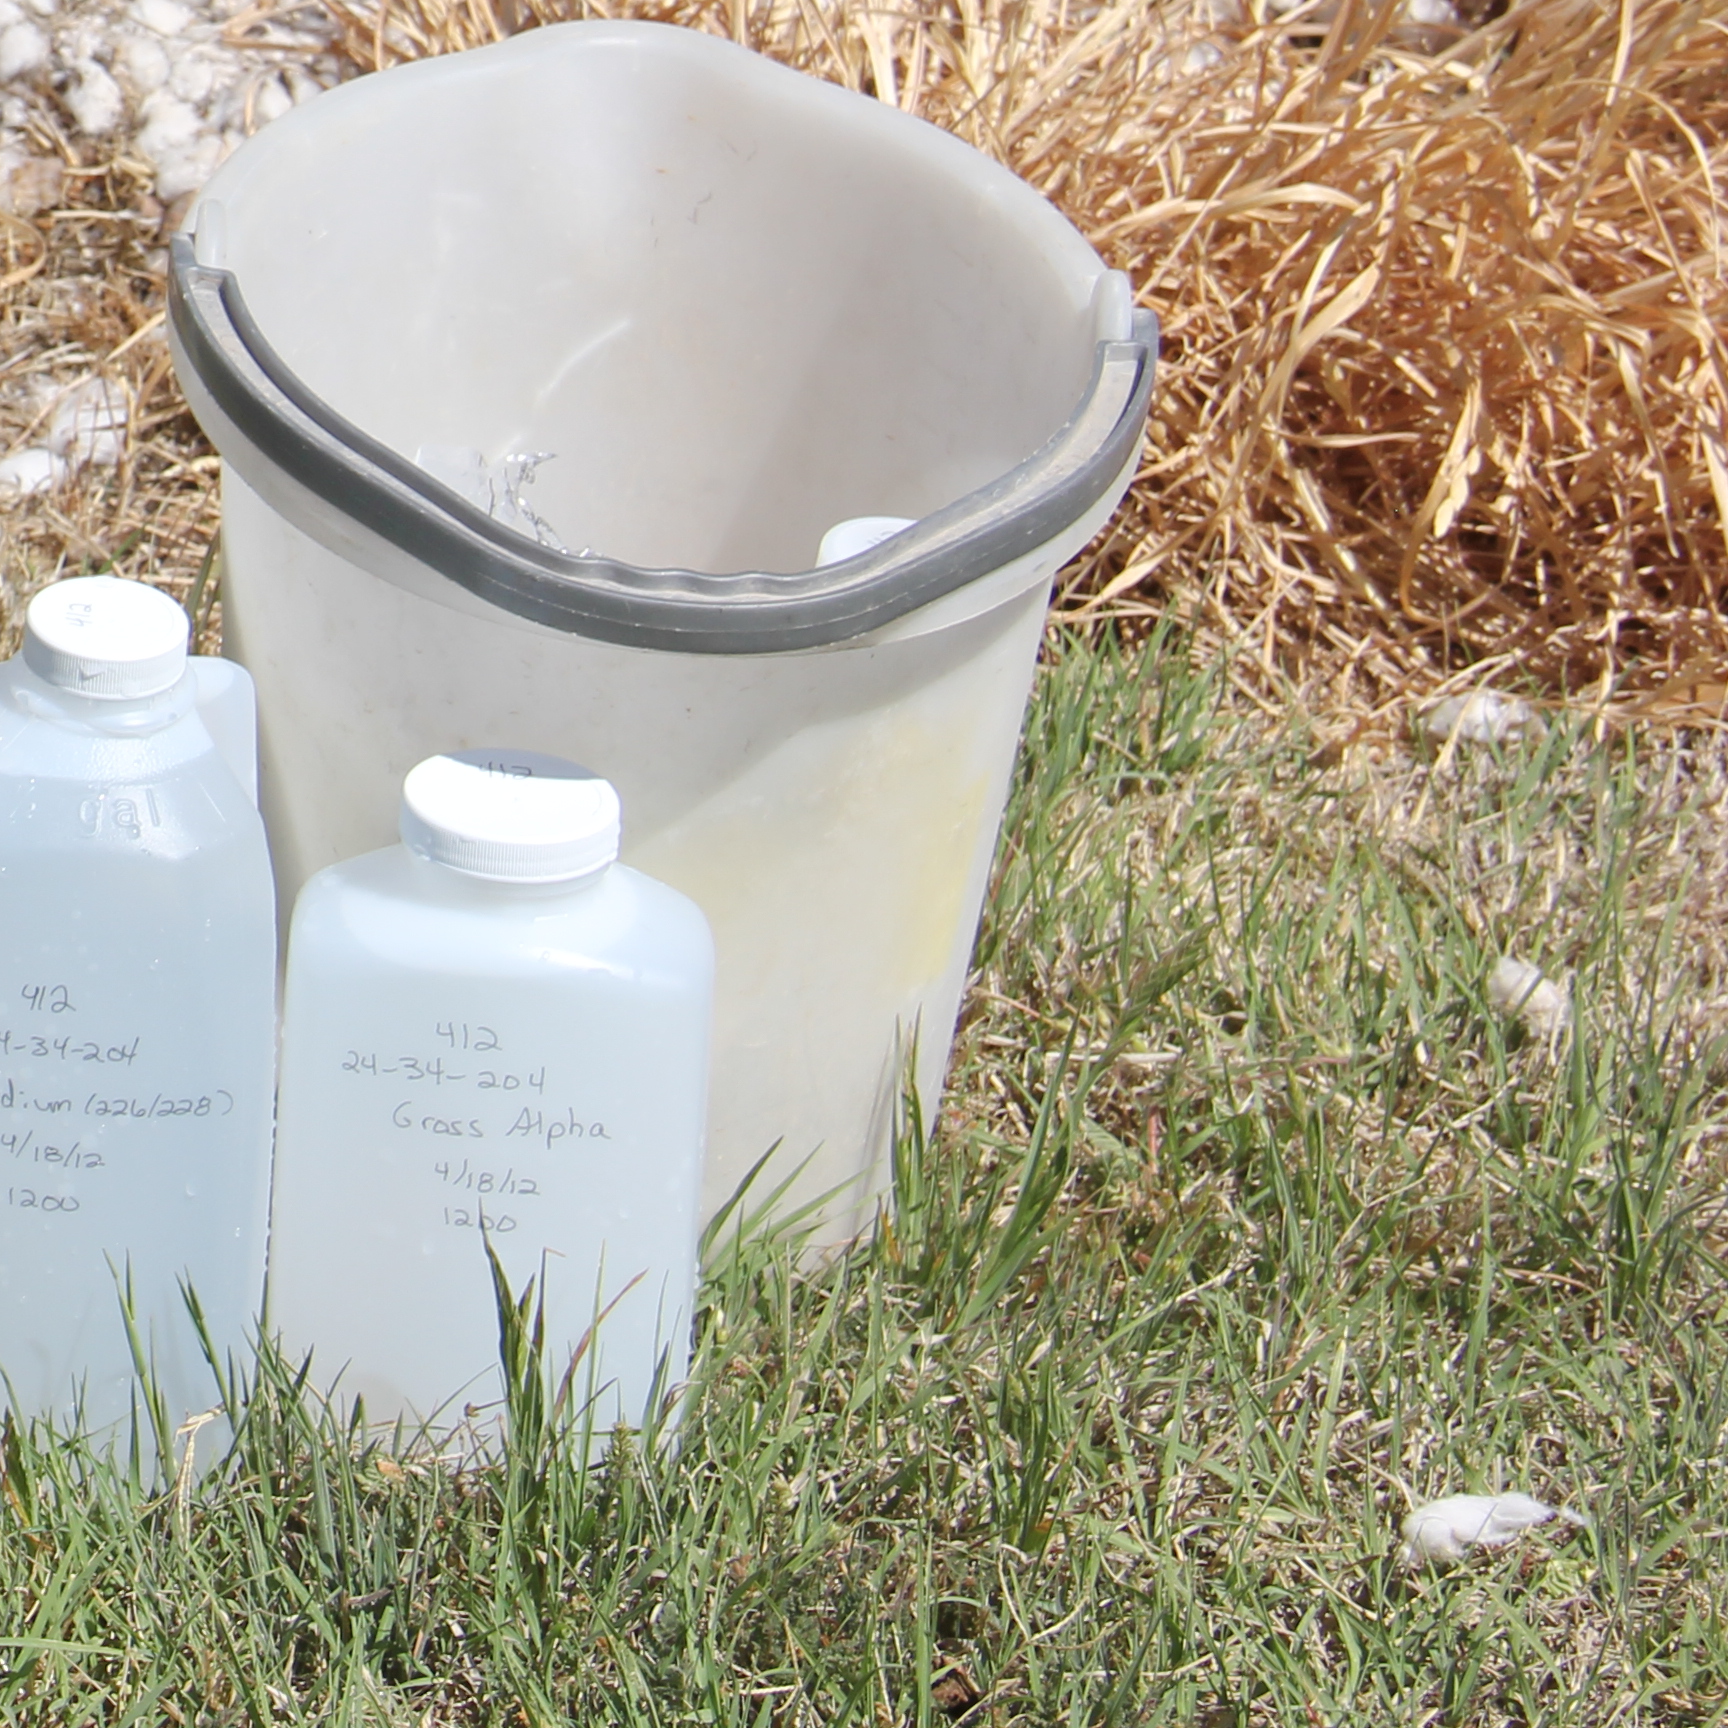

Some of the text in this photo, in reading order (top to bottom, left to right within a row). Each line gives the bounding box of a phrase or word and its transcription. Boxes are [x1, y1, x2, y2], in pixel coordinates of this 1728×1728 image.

[78, 786, 161, 839] gal
[21, 983, 77, 1013] 412
[436, 1021, 503, 1052] 412
[84, 1089, 235, 1118] (226/228)
[392, 1100, 612, 1151] Gross Alpha
[0, 1129, 106, 1169] 4/18/12
[434, 1158, 541, 1196] 4/18/12
[8, 1186, 81, 1213] 1200
